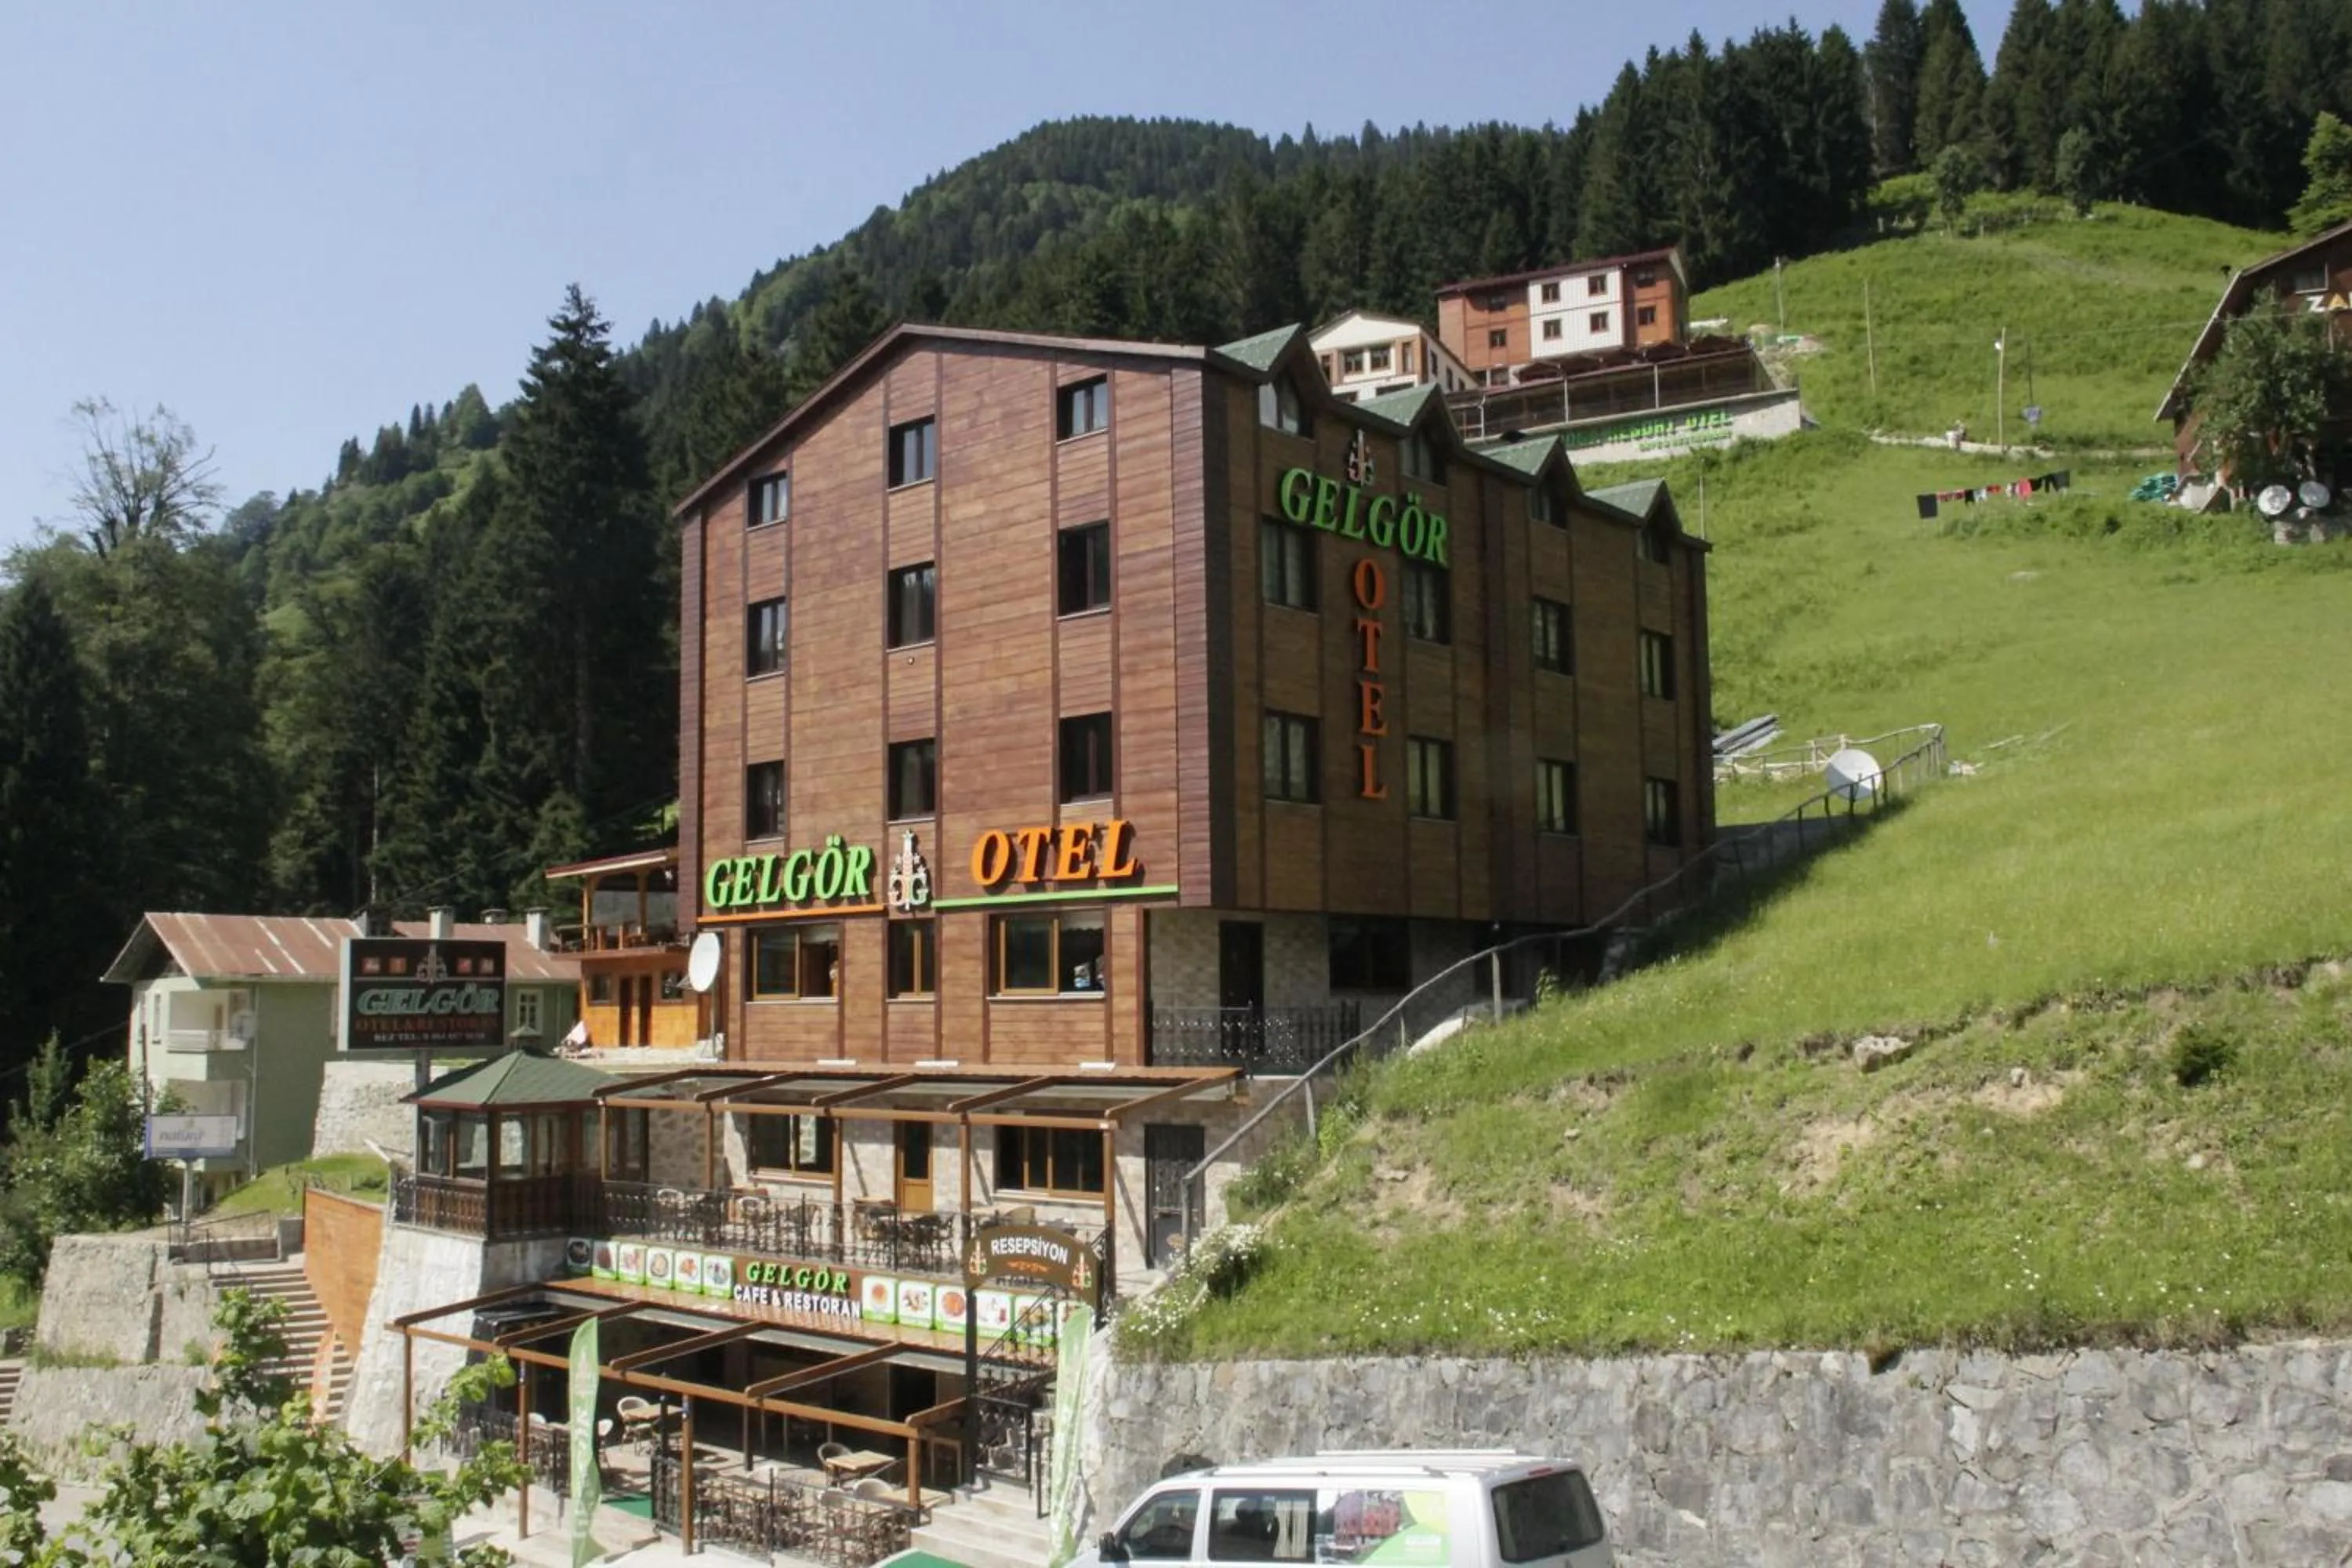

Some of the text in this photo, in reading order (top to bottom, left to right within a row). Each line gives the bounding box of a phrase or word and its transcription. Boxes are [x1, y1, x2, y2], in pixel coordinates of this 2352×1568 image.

[2306, 291, 2352, 313] ZA
[1280, 467, 1449, 567] GELGÖR
[1354, 558, 1388, 800] OTEL
[706, 819, 1138, 908] GELGÖR OTEL
[357, 983, 499, 1014] GELGÖR
[990, 1236, 1068, 1265] RESEPSİYON
[746, 1261, 848, 1294] GELGÖR
[734, 1283, 861, 1319] CAFE & RESTORAN
